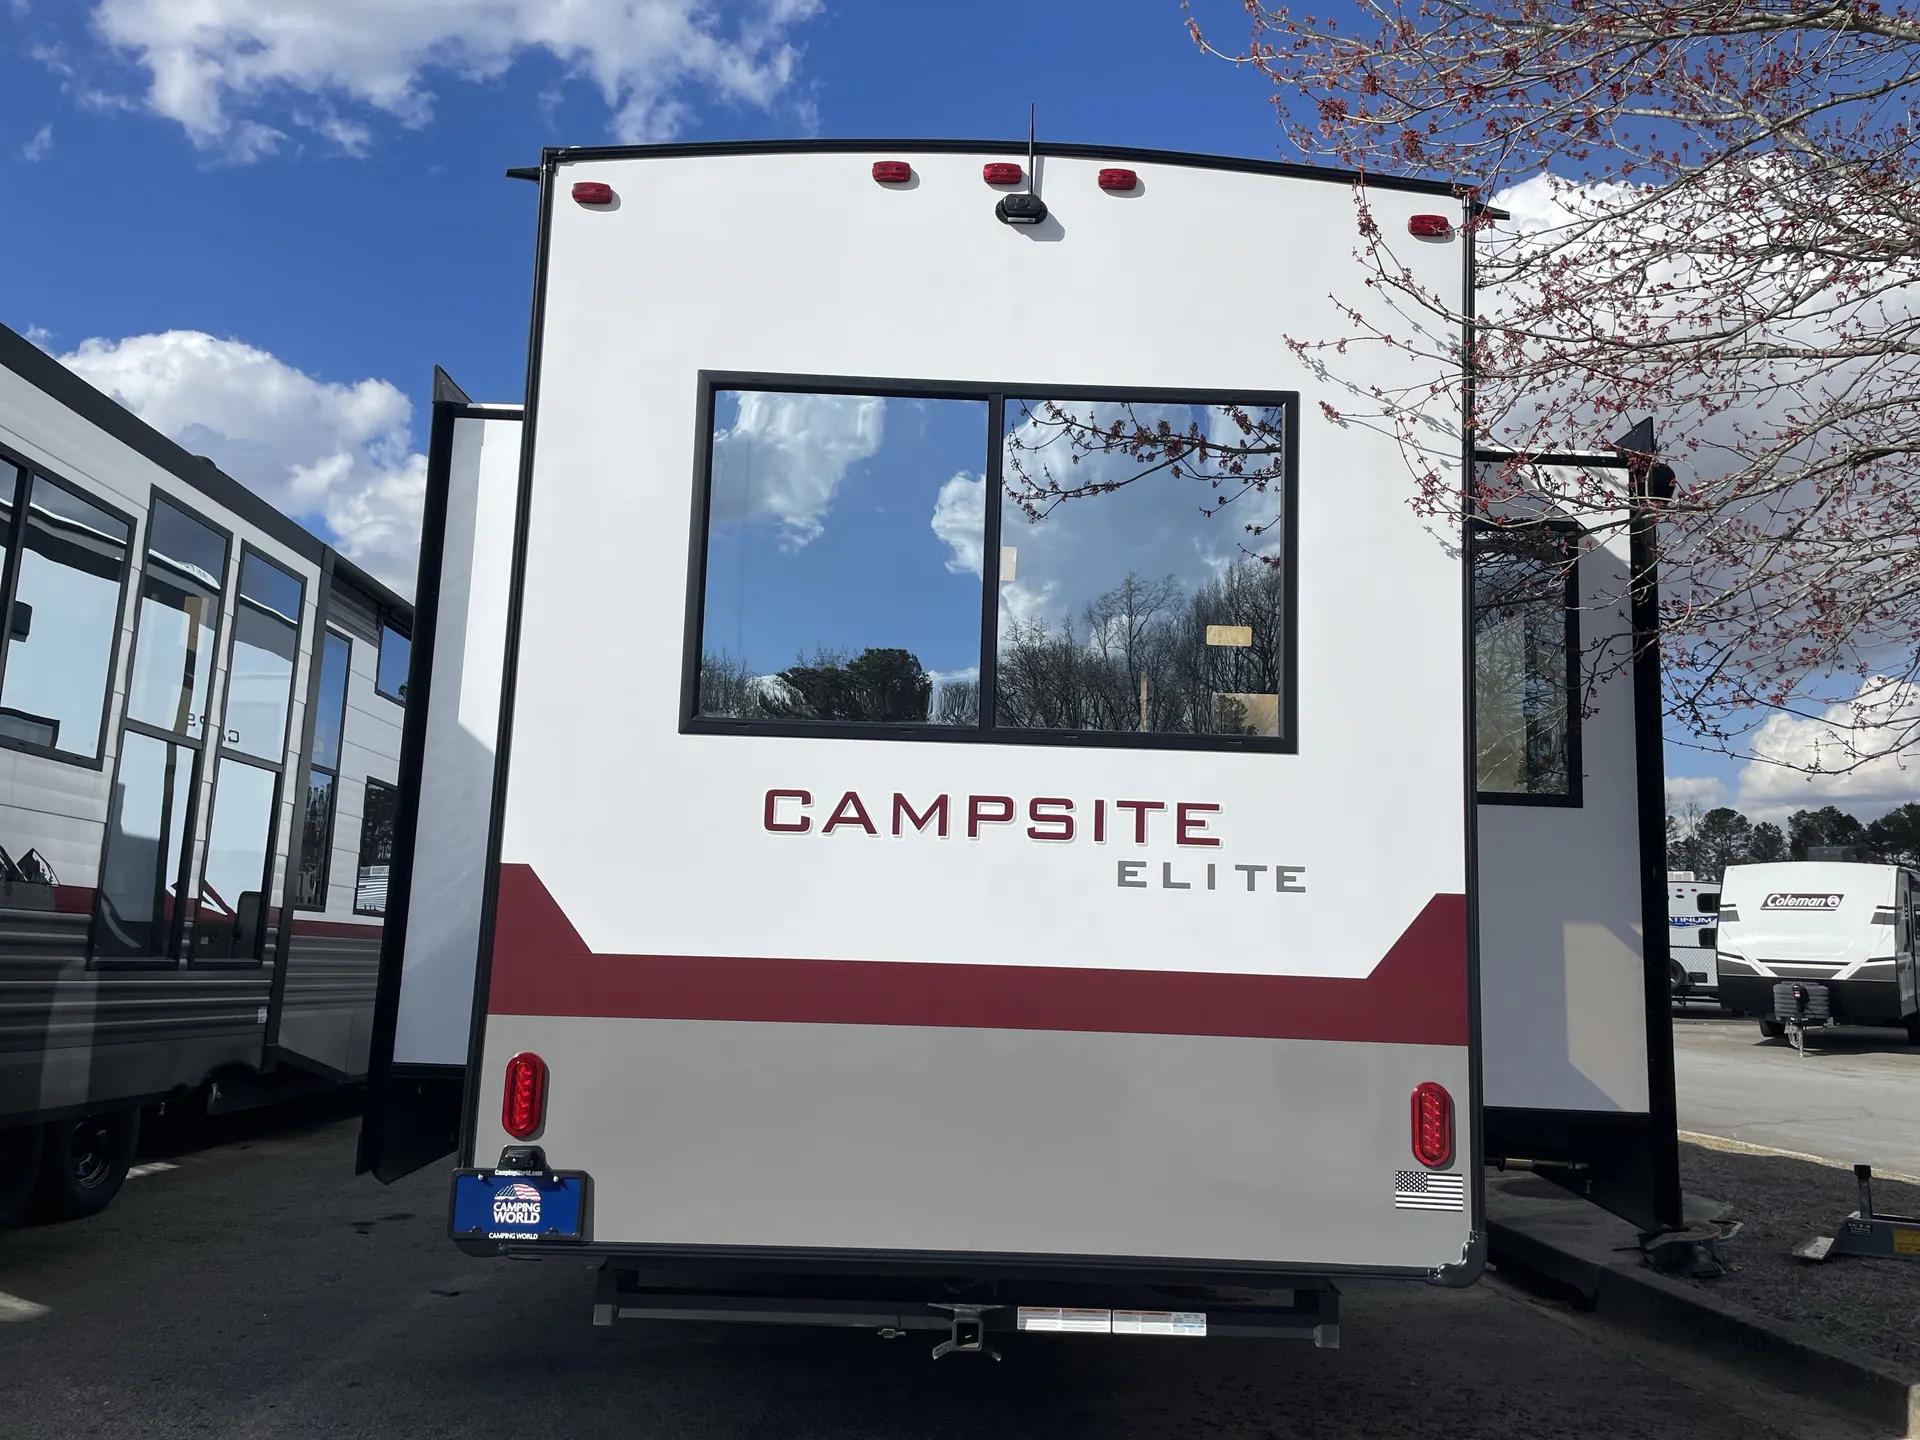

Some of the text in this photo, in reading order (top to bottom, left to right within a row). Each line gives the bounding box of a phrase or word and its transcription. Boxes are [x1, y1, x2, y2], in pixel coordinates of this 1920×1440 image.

[763, 788, 1221, 847] CAMPSITE
[1117, 860, 1306, 893] ELITE
[1766, 894, 1827, 907] Coleman
[493, 1202, 541, 1213] CAMPING
[493, 1211, 541, 1224] WORLD
